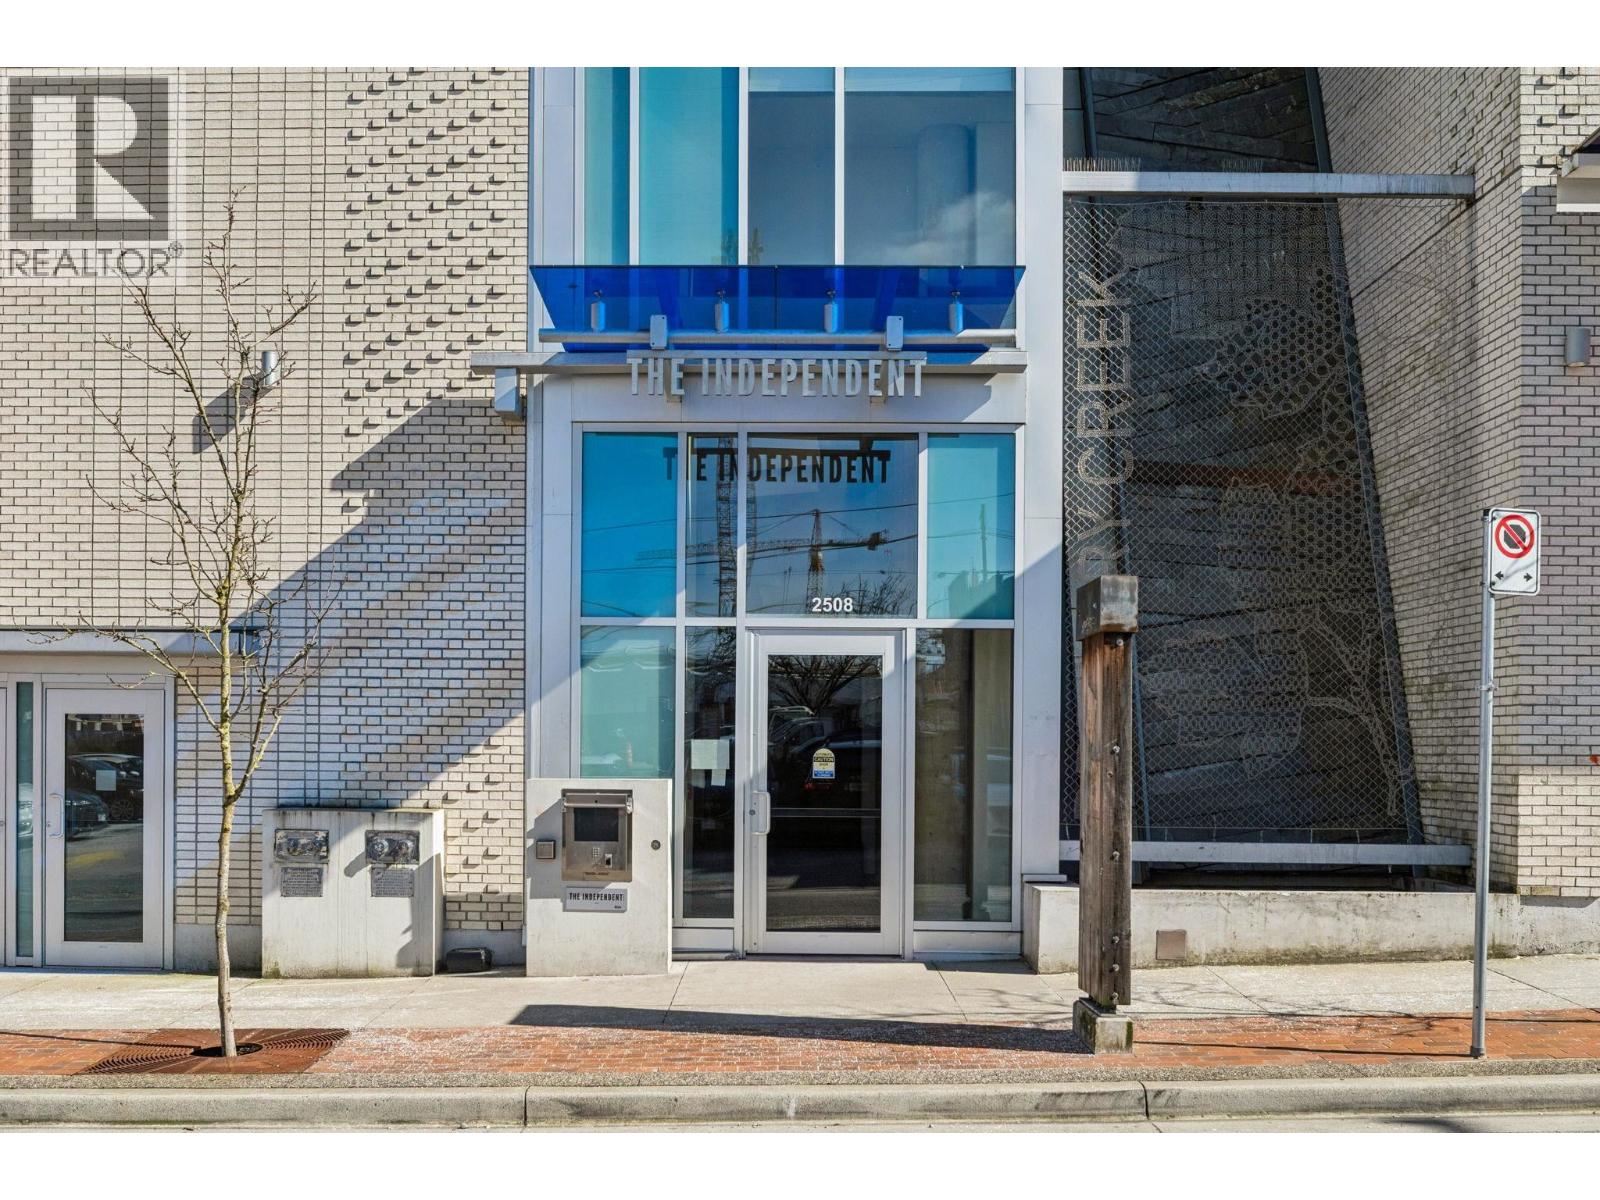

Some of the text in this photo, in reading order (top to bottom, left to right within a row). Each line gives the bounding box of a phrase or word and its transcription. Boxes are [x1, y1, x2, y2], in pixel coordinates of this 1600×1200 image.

[626, 357, 928, 398] THE INDEPENDENT
[1077, 265, 1134, 485] CREEK
[811, 597, 854, 613] 2508
[569, 892, 624, 902] THE INDEPENDENT
